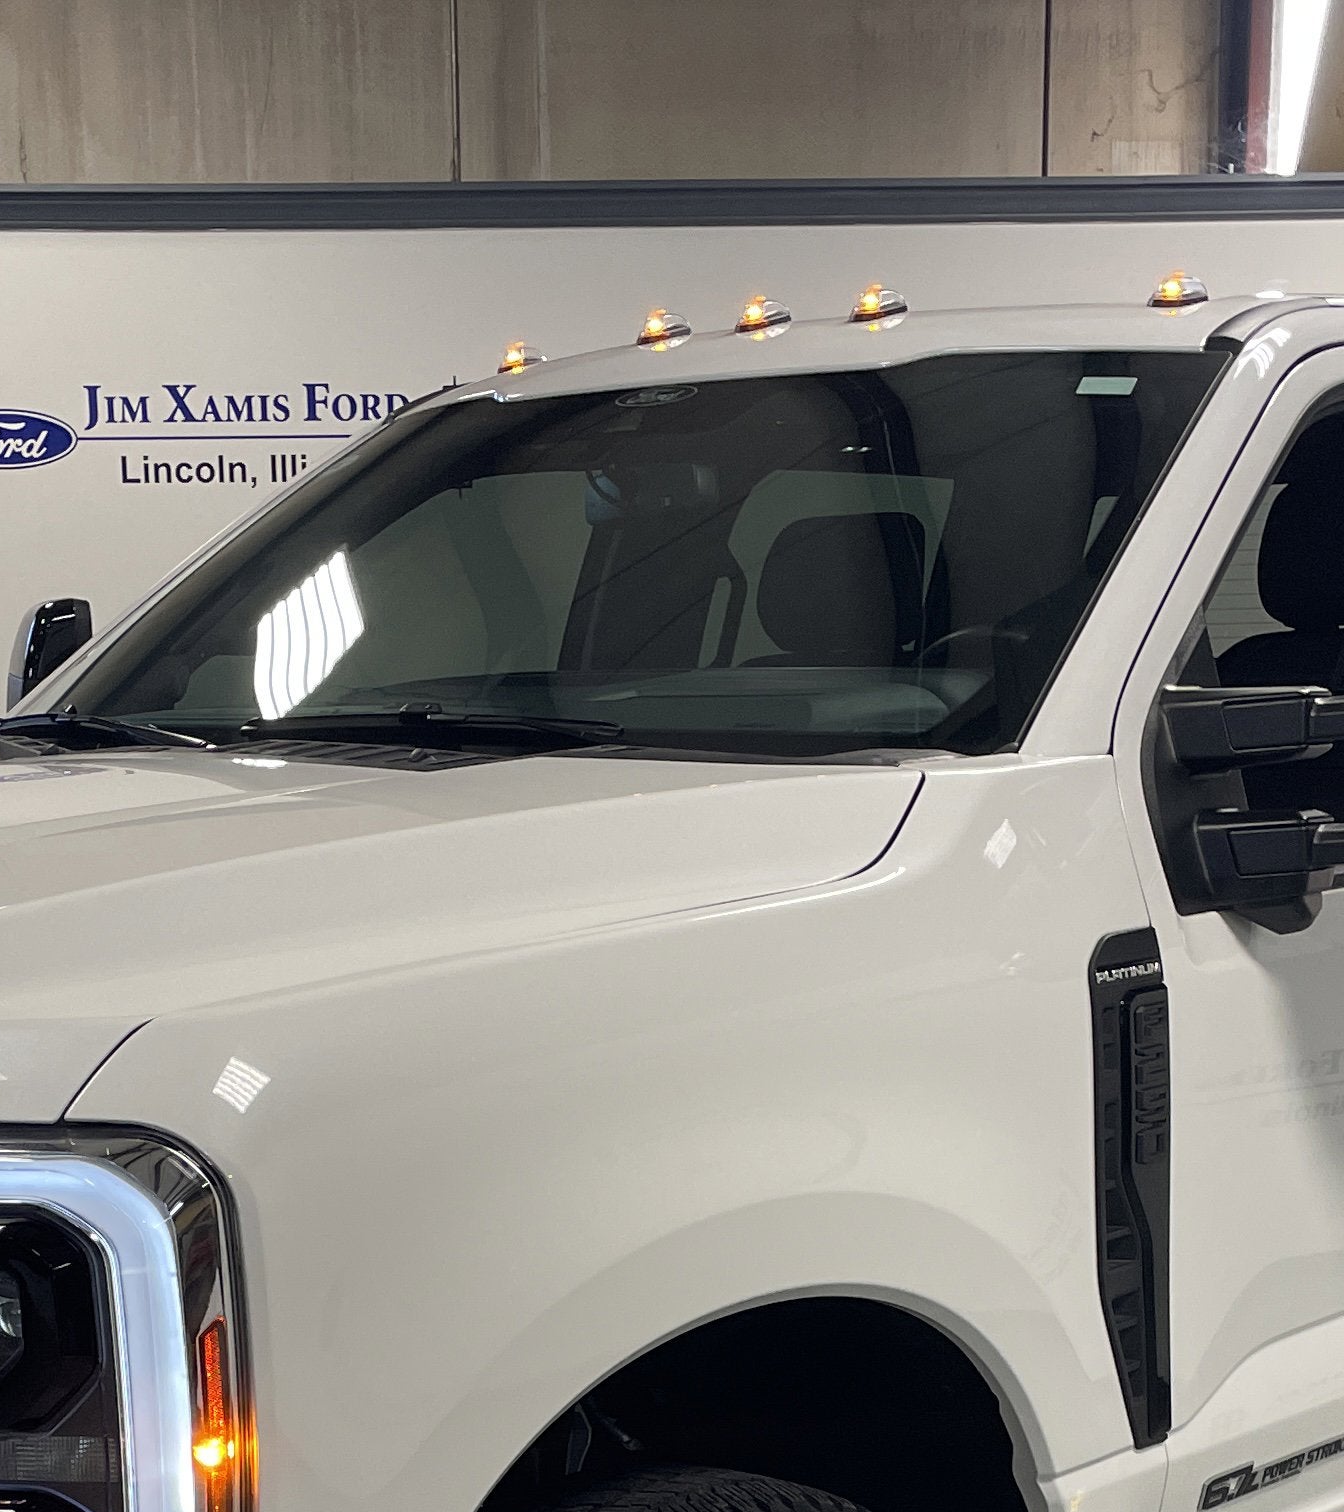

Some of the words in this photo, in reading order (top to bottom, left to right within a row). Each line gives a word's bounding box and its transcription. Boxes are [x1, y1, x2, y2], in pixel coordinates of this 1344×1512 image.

[83, 384, 151, 430] JIM
[162, 384, 290, 423] XAMIS
[121, 455, 258, 488] Lincoln,
[1096, 962, 1161, 984] PLATINUM
[1261, 1453, 1305, 1483] POWER
